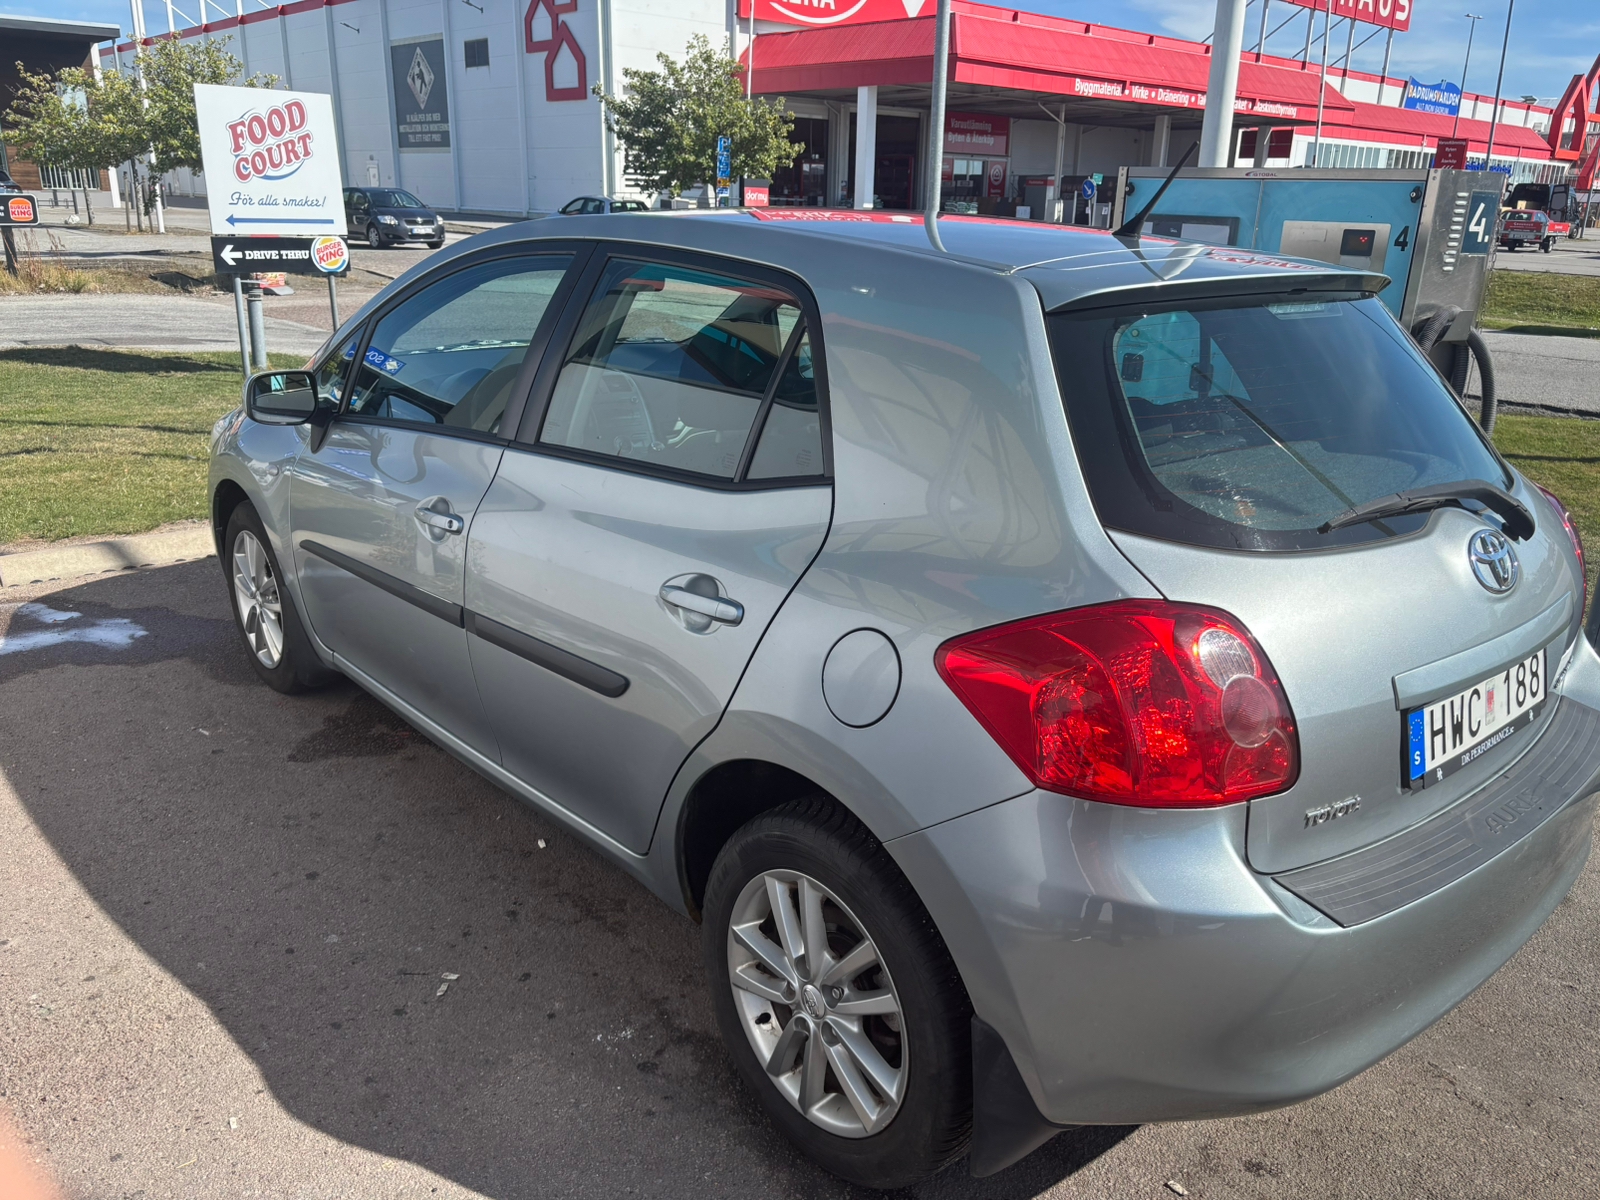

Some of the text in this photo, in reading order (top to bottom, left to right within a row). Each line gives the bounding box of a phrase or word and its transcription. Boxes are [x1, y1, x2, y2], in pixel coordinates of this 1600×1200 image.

[1075, 78, 1123, 98] Byggmaterial
[1132, 85, 1149, 100] Virke
[1157, 88, 1190, 107] Dränering
[227, 100, 307, 154] FOOD
[234, 131, 313, 182] COURT
[228, 191, 327, 208] För alla smaker!
[745, 189, 768, 204] dormy
[315, 241, 342, 255] BURGER
[1394, 225, 1410, 252] 4
[245, 250, 310, 260] DRIVE THRU
[317, 247, 344, 266] KING
[1430, 687, 1481, 762] HWC
[1503, 653, 1540, 717] 188
[1413, 750, 1421, 766] S
[1303, 795, 1361, 830] TOYOTA
